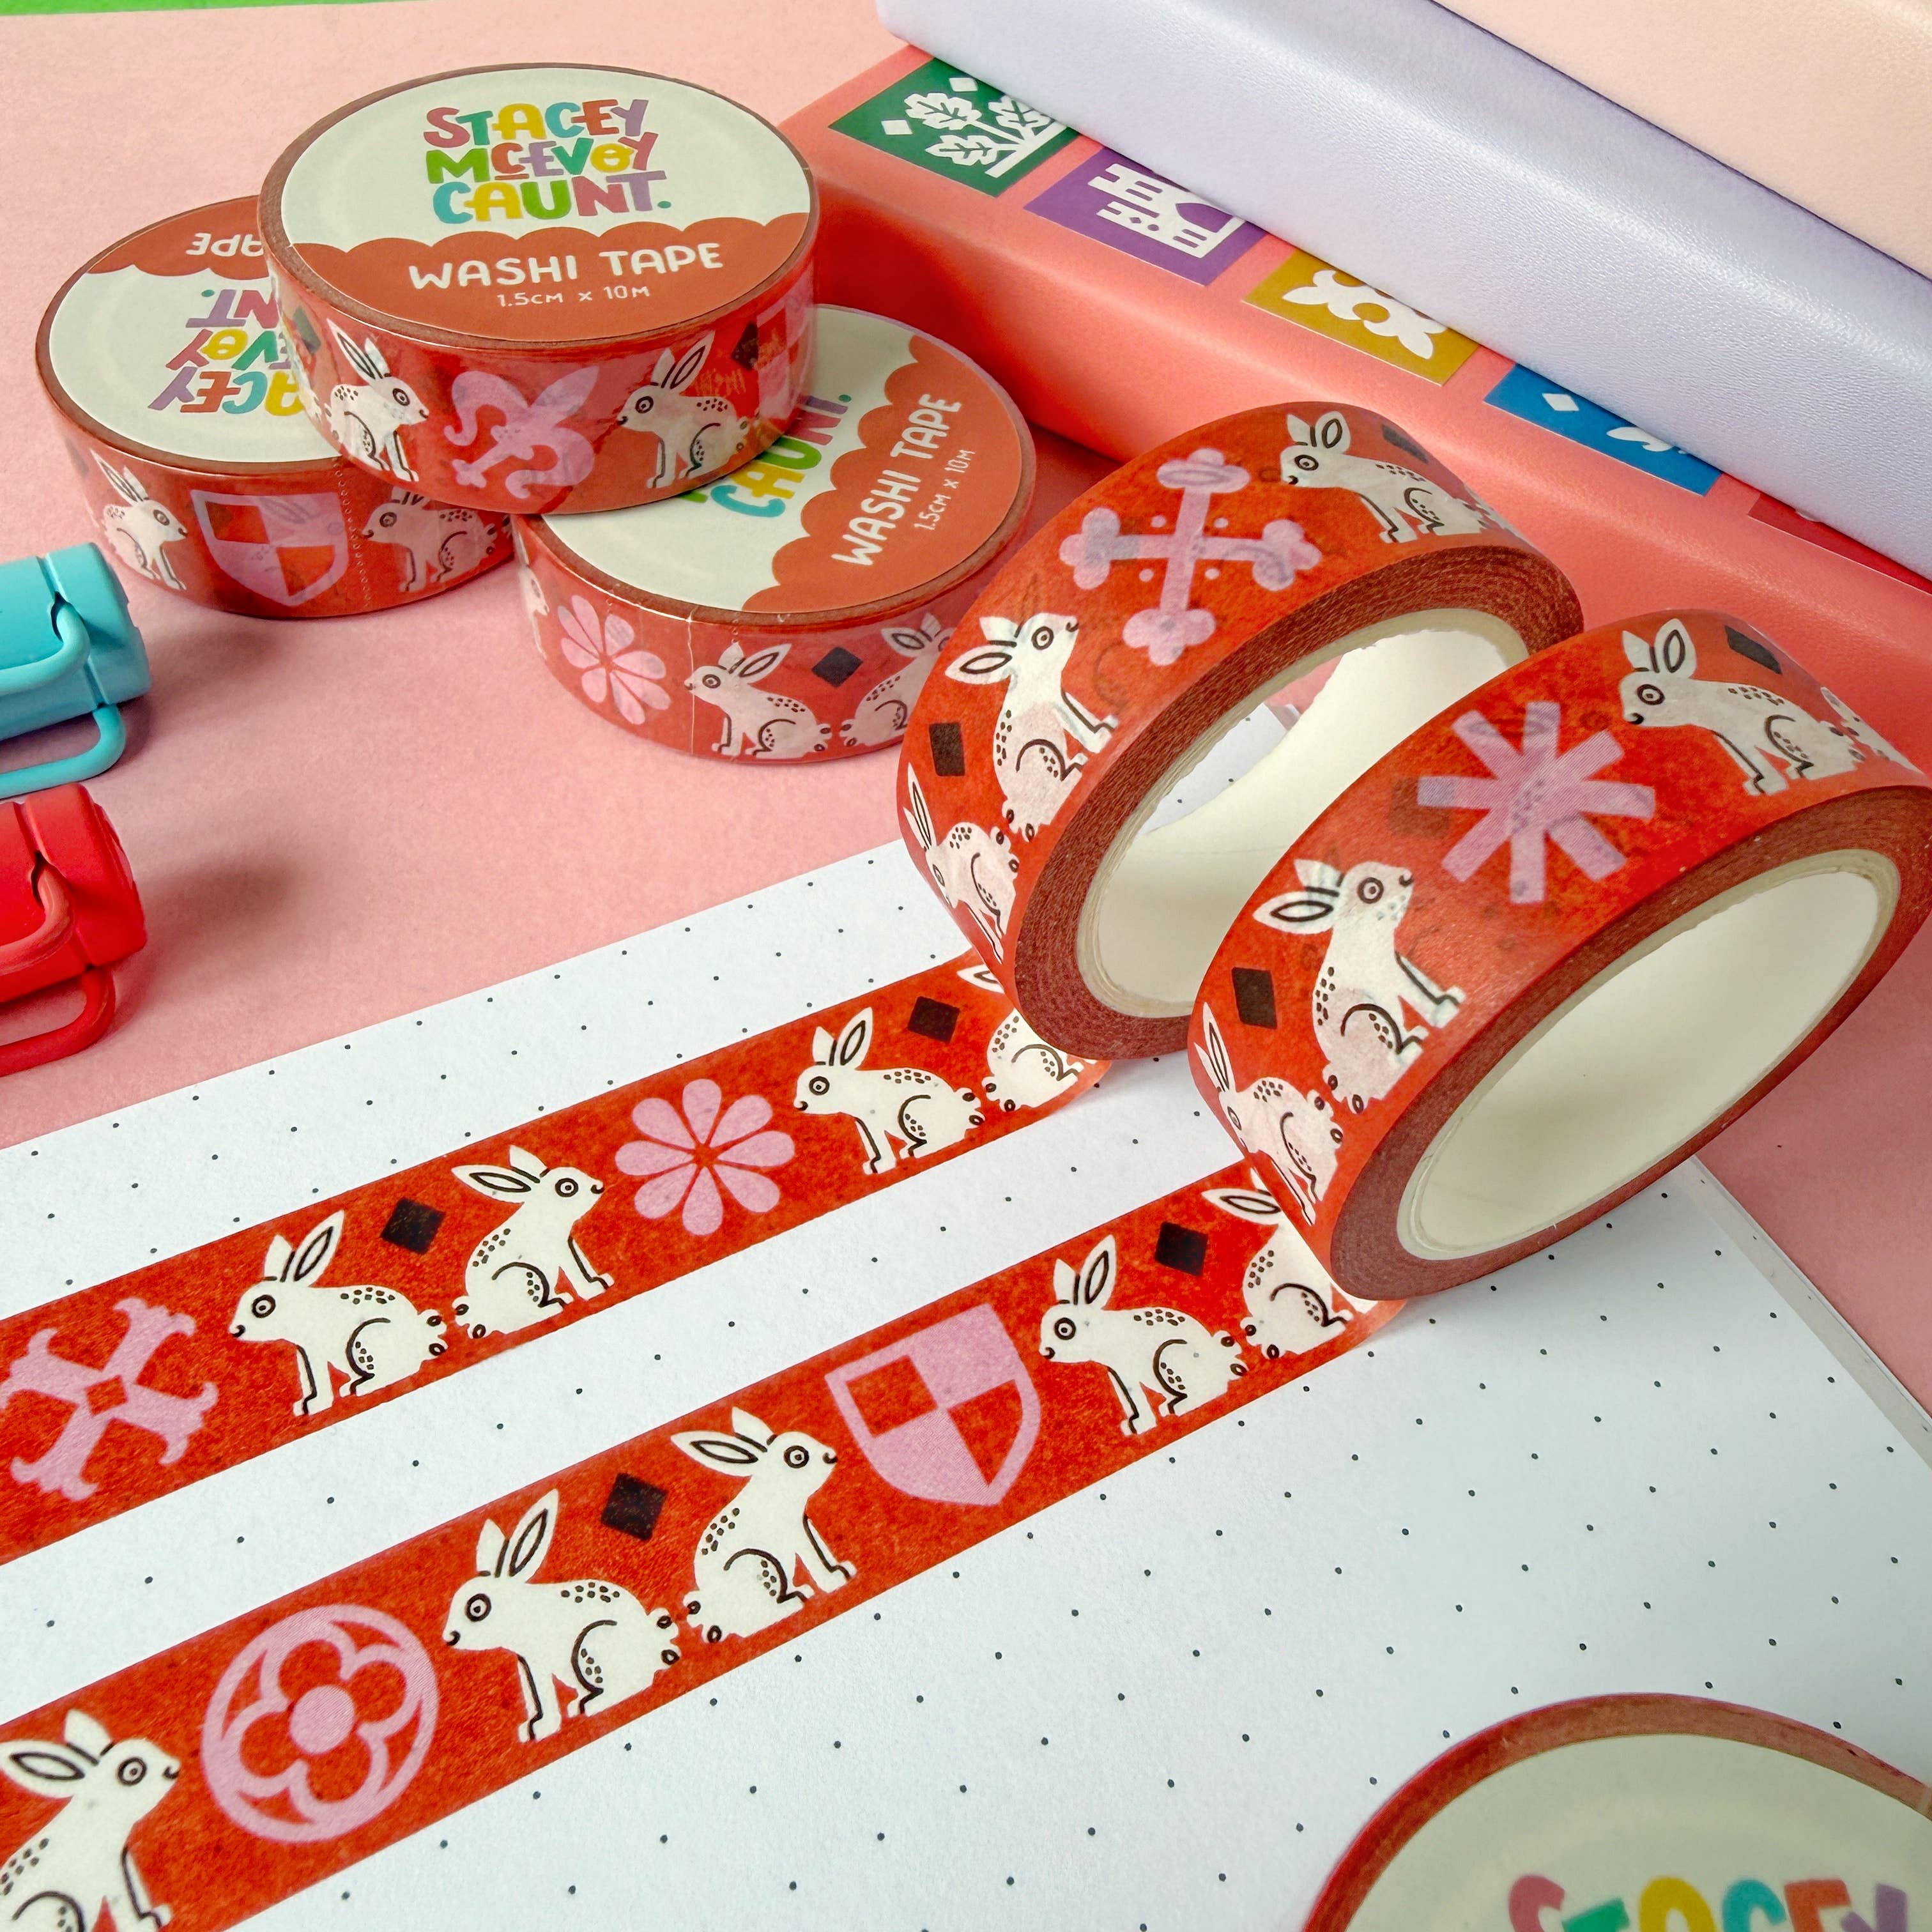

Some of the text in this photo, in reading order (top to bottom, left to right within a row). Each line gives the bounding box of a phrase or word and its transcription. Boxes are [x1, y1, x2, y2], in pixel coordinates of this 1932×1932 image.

[424, 99, 648, 148] STACEY
[433, 171, 671, 224] CAUNT.
[186, 233, 264, 257] APE
[409, 243, 723, 289] WASHI TAPE
[148, 366, 304, 416] ACEY
[831, 394, 962, 565] WASHI TAPE
